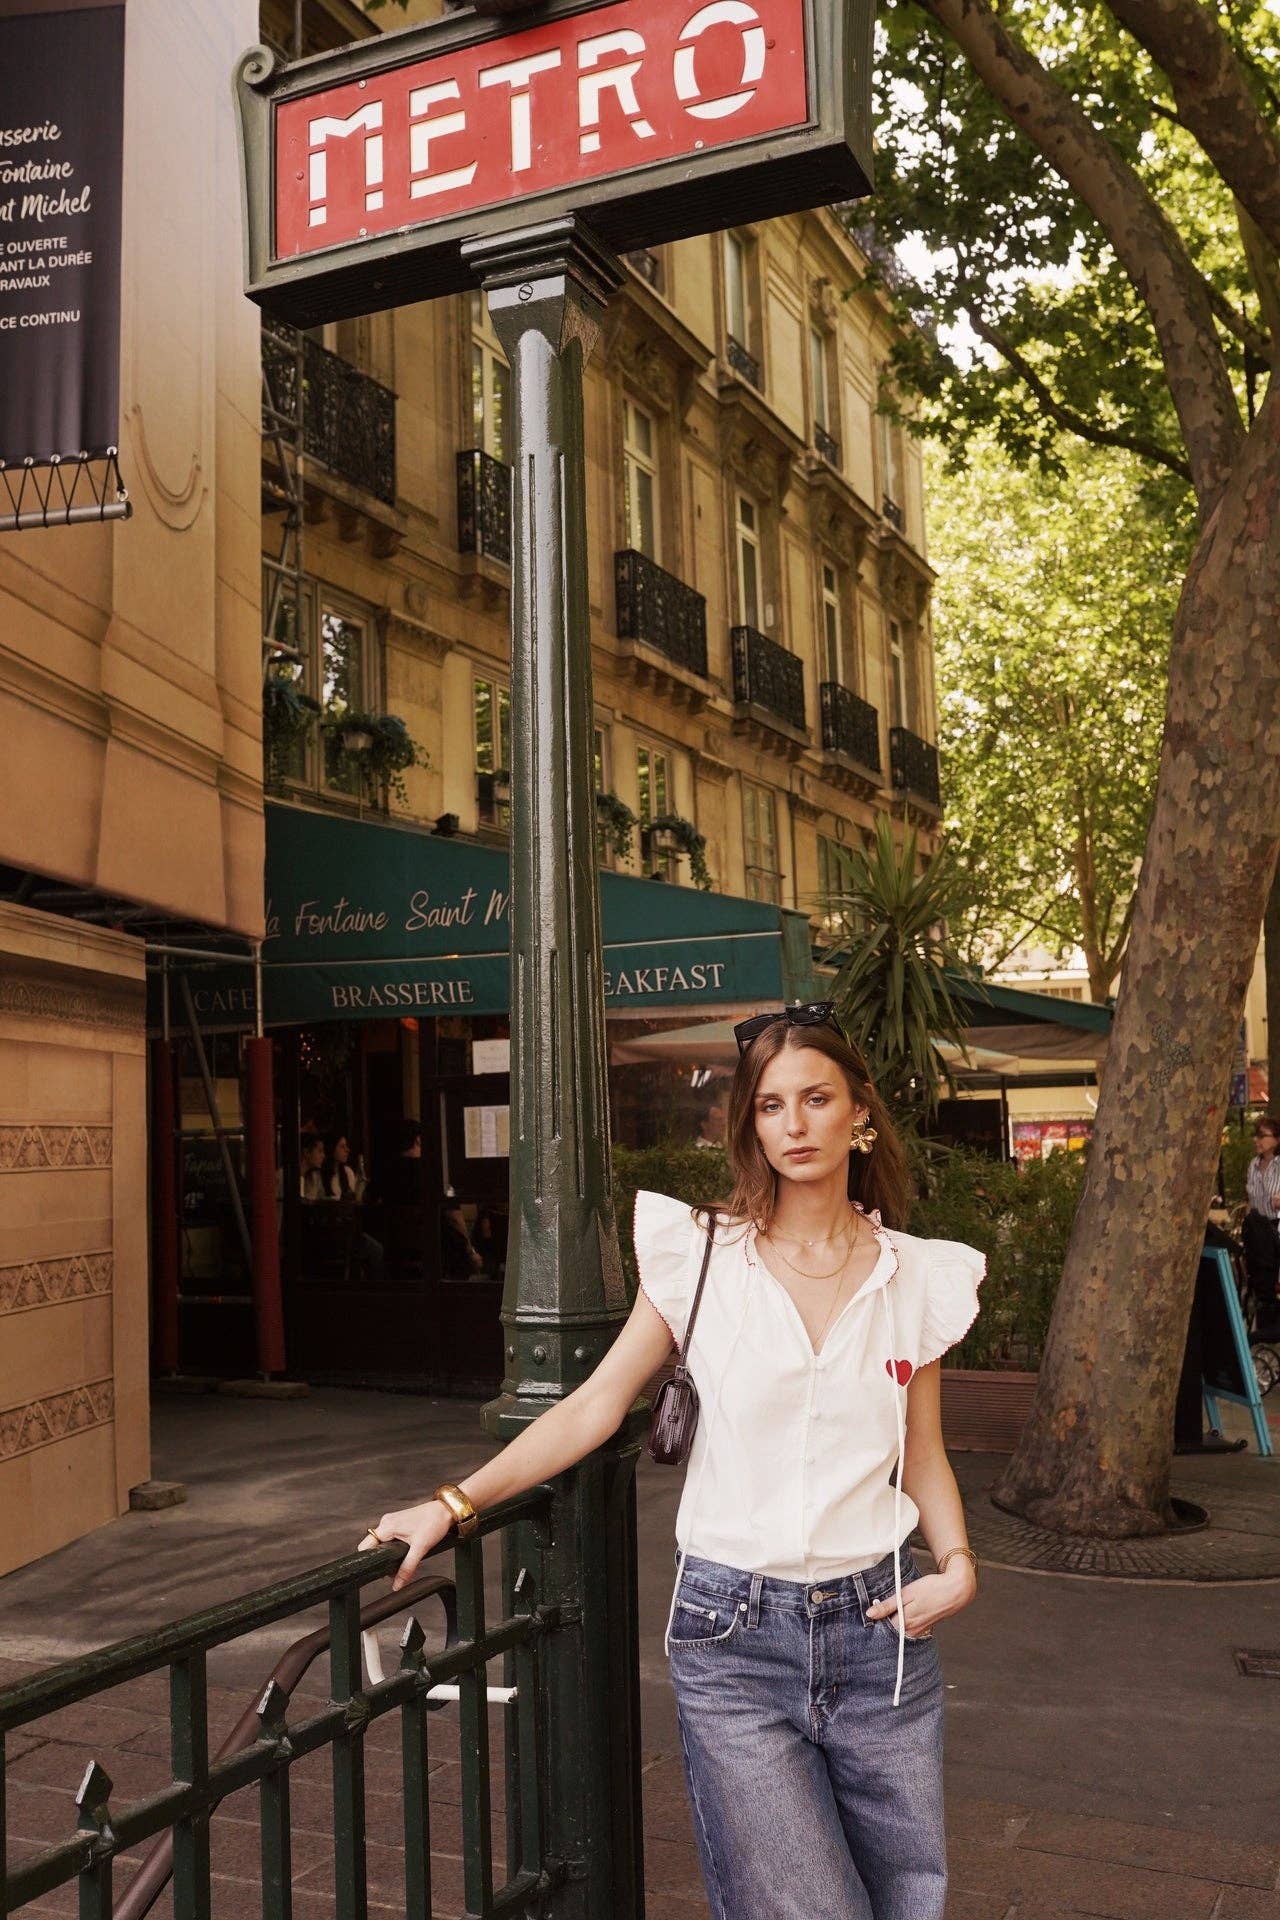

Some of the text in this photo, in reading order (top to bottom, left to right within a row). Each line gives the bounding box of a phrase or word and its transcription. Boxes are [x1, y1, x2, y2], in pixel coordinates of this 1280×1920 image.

[308, 0, 766, 227] METRO
[21, 185, 91, 223] Michel
[6, 236, 68, 254] OUVERTE
[28, 257, 46, 270] LA
[48, 250, 93, 268] DURÉE
[20, 310, 80, 327] CONTINU
[295, 896, 390, 936] Fontaine
[405, 887, 478, 931] Saint
[330, 981, 474, 1008] BRASSERIE
